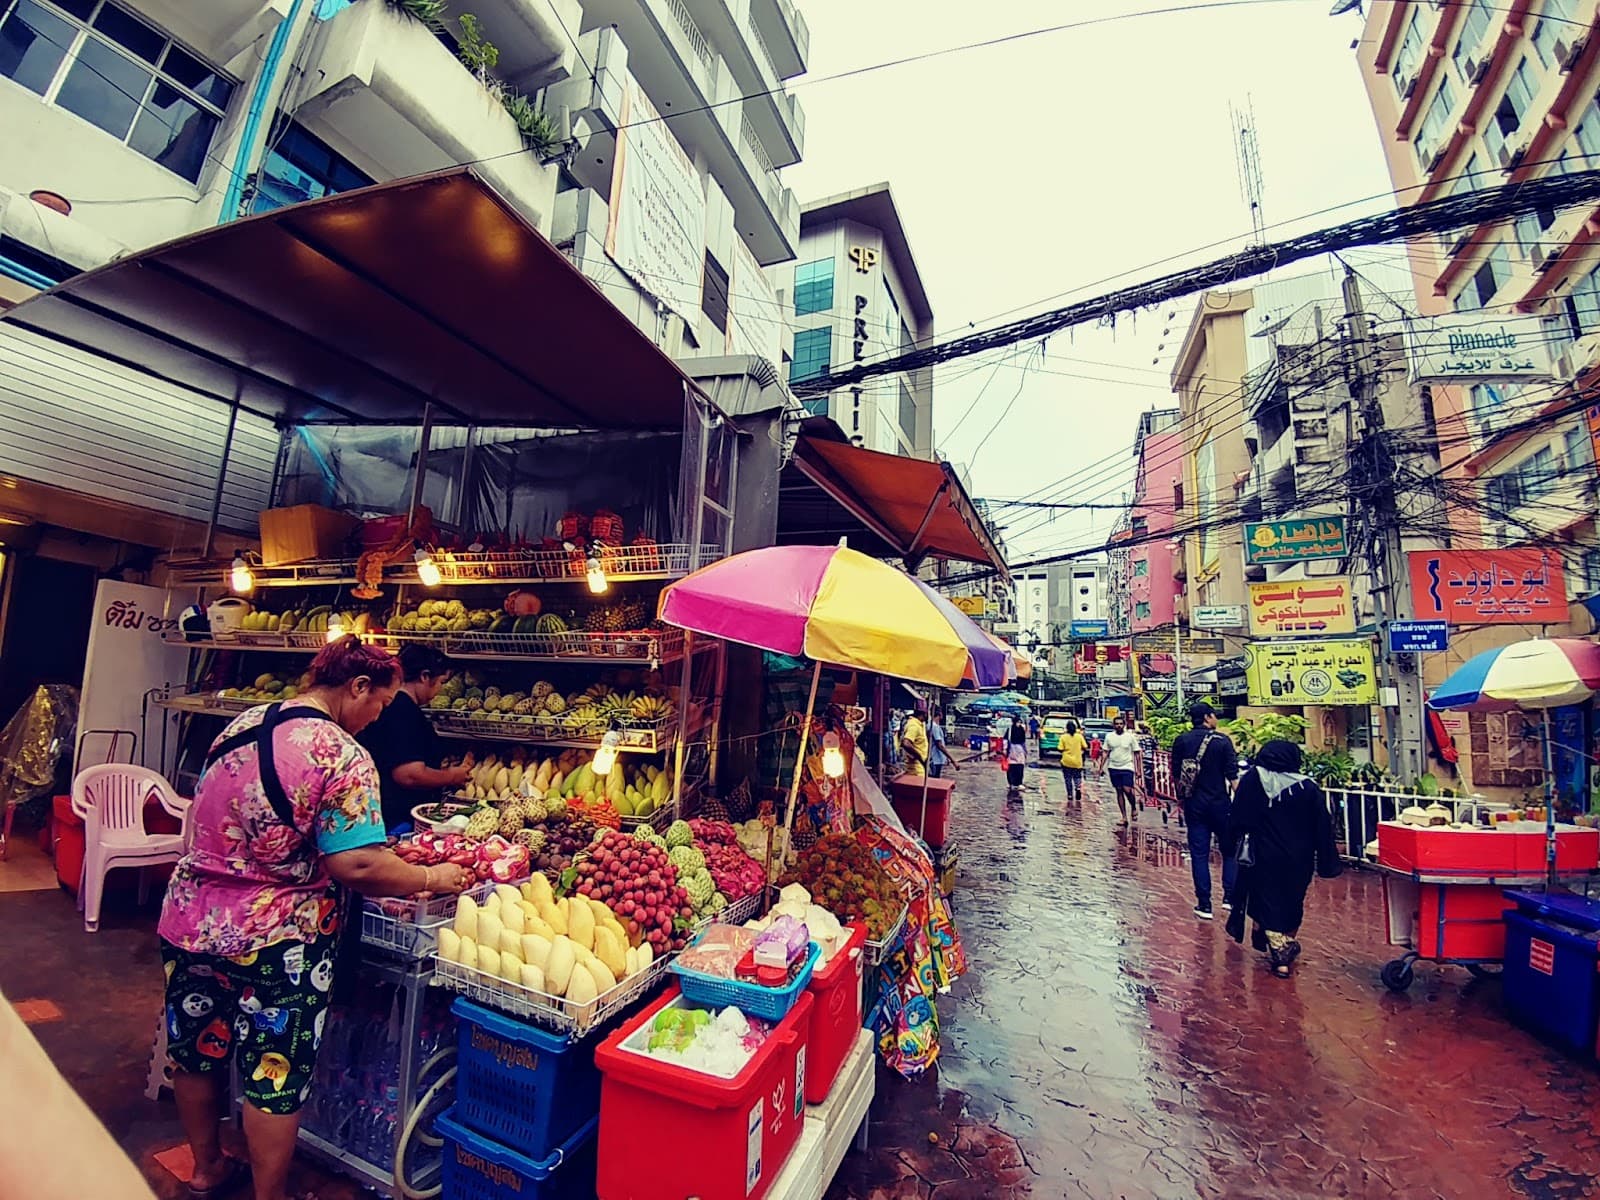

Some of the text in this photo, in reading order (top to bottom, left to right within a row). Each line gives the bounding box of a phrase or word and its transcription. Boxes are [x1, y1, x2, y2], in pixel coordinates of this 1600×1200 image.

[1448, 325, 1518, 355] pinnacle
[1500, 358, 1535, 372] غرف
[1266, 657, 1299, 669] الرحمن
[1302, 658, 1320, 669] عبد
